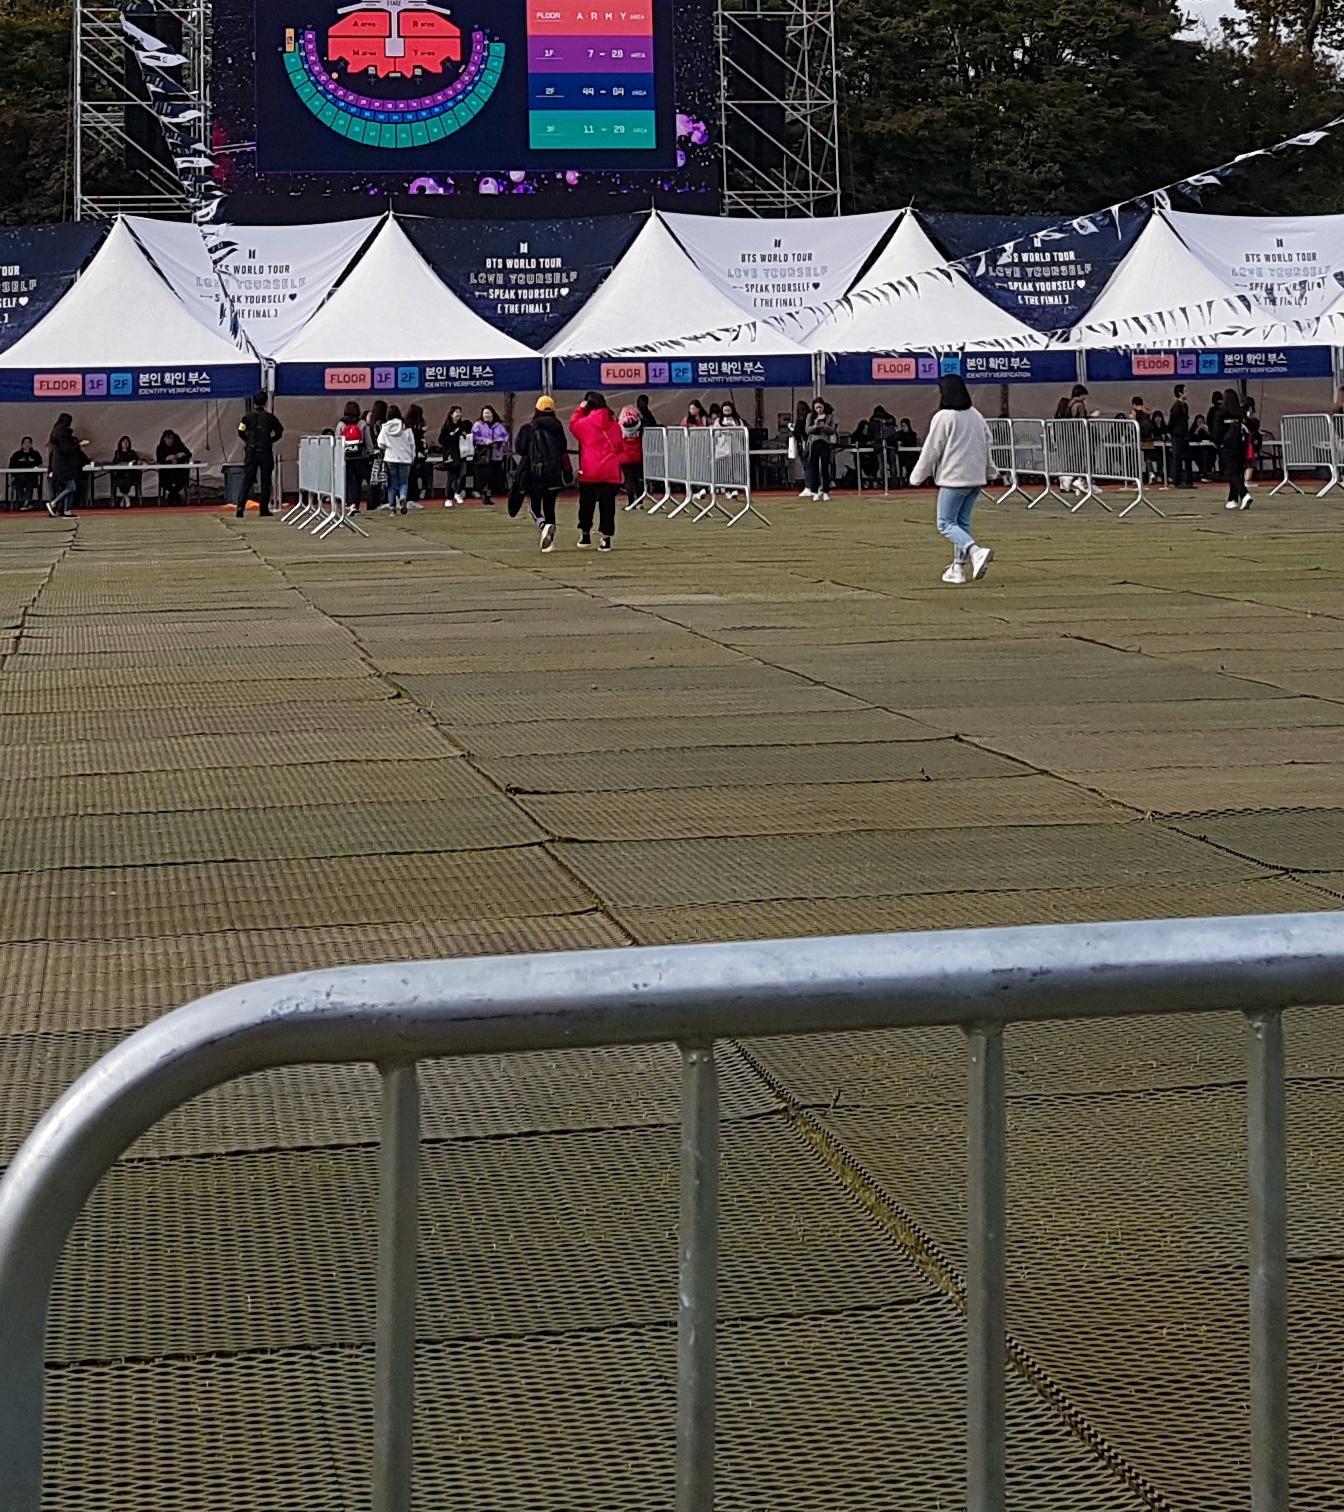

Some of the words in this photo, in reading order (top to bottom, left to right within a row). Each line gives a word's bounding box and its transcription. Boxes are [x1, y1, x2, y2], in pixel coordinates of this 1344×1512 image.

[741, 254, 756, 263] BTS
[760, 254, 789, 263] WORLD
[792, 253, 813, 262] TOUR
[1021, 252, 1051, 262] WORLD
[1053, 251, 1076, 261] TOUR
[486, 258, 503, 269] BTS
[506, 259, 536, 269] WORLD
[539, 258, 562, 268] TOUR
[234, 265, 264, 275] WORLD
[268, 264, 290, 274] TOUR
[727, 268, 757, 278] LOVE
[763, 266, 828, 278] YOURSELF
[469, 273, 504, 284] LOVE
[509, 271, 578, 284] YOURSELF
[745, 283, 770, 293] SPEAK
[772, 282, 810, 293] YOURSELF
[1007, 281, 1034, 291] SPEAK
[1035, 280, 1075, 291] YOURSELF
[245, 294, 286, 304] YOURSELF
[489, 288, 515, 299] SPEAK
[518, 288, 559, 299] YOURSELF
[877, 364, 911, 373] FLOOR
[922, 364, 934, 373] 1F
[966, 357, 986, 371] 본인
[989, 357, 1008, 370] 확인
[1010, 357, 1031, 369] 부스
[1137, 359, 1169, 369] FLOOR
[1181, 359, 1193, 368] 1F
[1202, 359, 1215, 368] 2F
[1224, 353, 1244, 366] 본인
[1246, 353, 1266, 365] 확인
[1268, 353, 1288, 364] 부스
[330, 374, 366, 383] FLOOR
[377, 374, 391, 383] 1F
[401, 373, 415, 383] 2F
[425, 366, 447, 380] 본인
[449, 366, 470, 379] 확인
[472, 366, 494, 378] 부스
[607, 369, 641, 378] FLOOR
[652, 369, 665, 378] 1F
[675, 368, 689, 378] 2F
[698, 362, 719, 375] 본인
[721, 361, 742, 375] 확인
[744, 362, 765, 374] 부스
[39, 380, 77, 390] FLOOR
[89, 380, 103, 390] 1F
[114, 379, 129, 389] 2F
[139, 372, 161, 386] 본인
[164, 372, 186, 386] 확인
[188, 372, 211, 384] 부스
